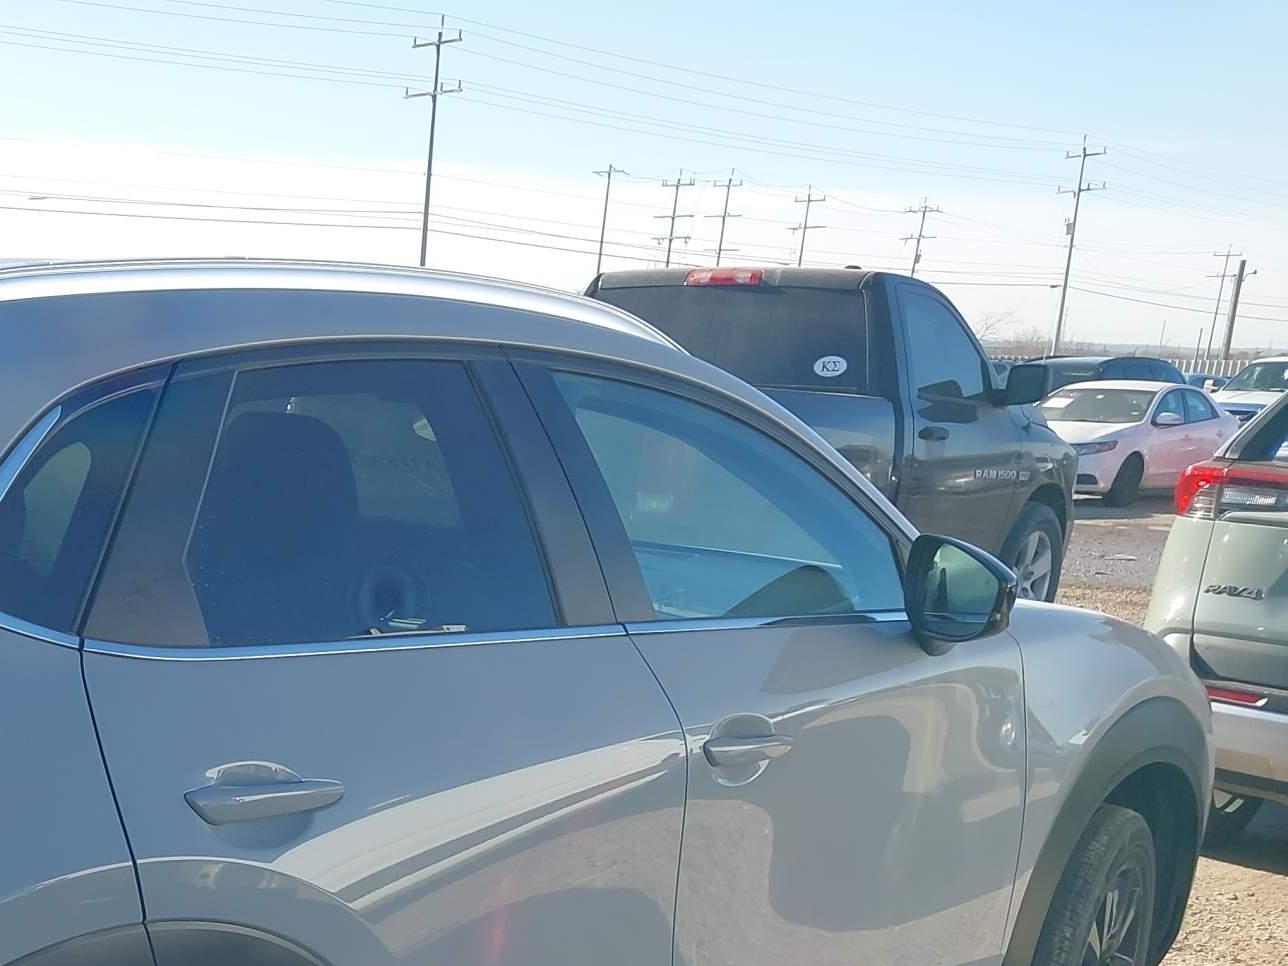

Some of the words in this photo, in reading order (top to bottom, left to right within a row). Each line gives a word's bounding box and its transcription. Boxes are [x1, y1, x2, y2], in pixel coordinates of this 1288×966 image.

[975, 469, 997, 480] RAM
[998, 470, 1017, 480] 1500
[1204, 584, 1264, 601] RAV4
